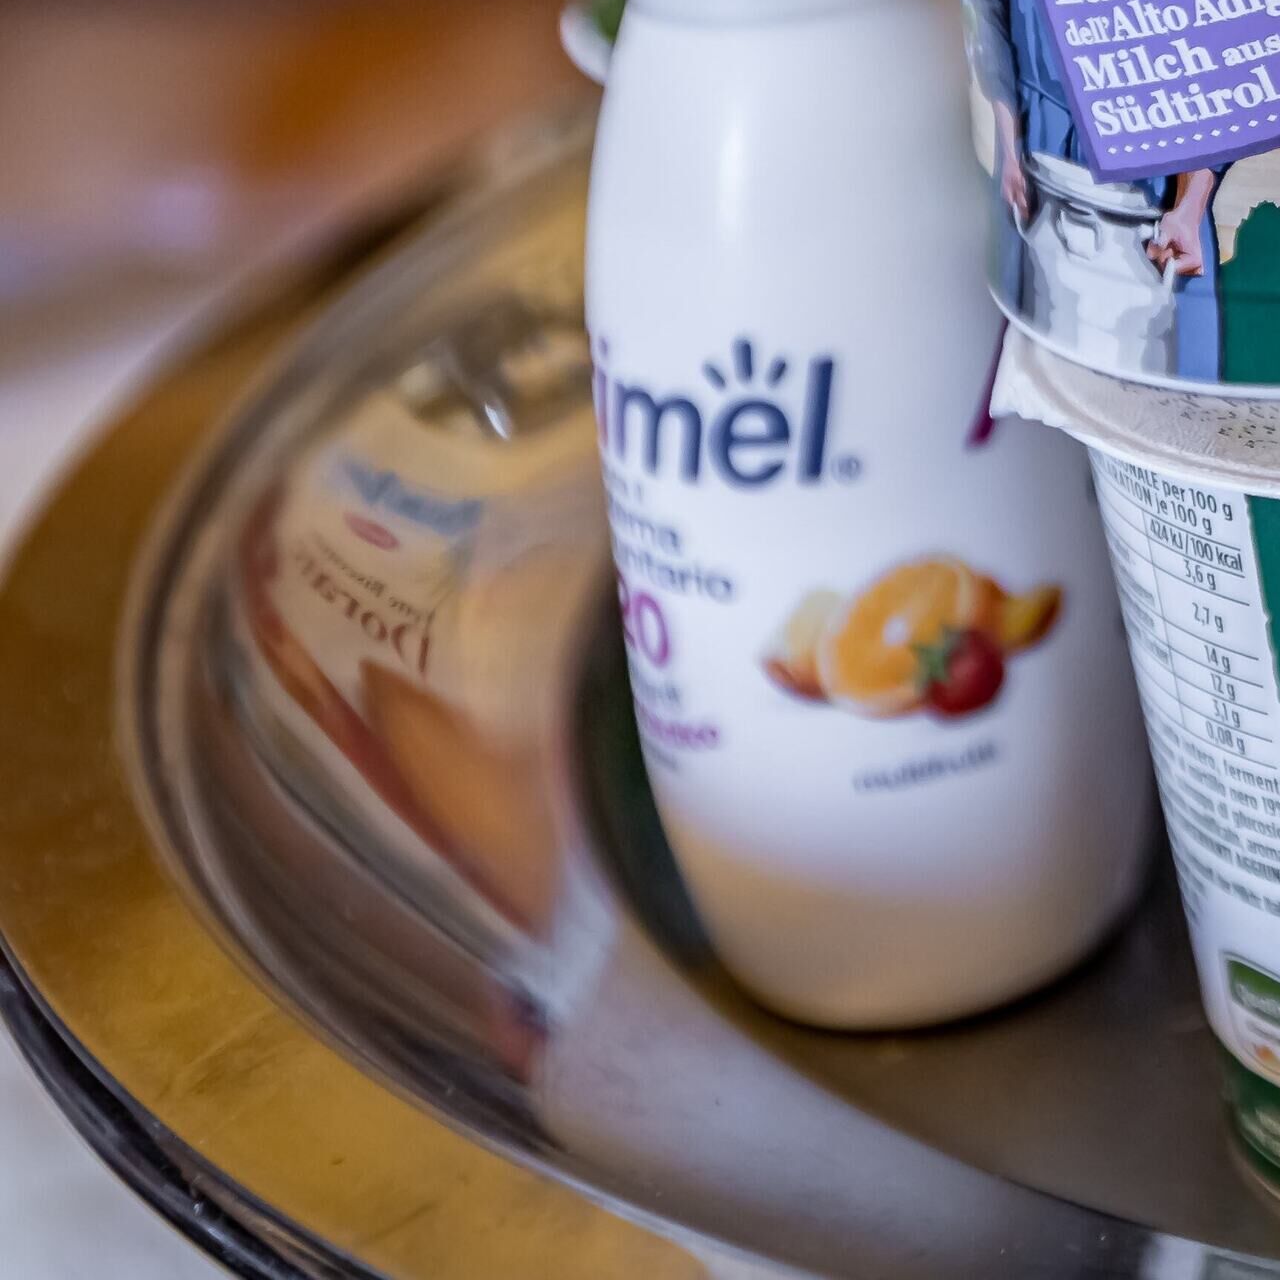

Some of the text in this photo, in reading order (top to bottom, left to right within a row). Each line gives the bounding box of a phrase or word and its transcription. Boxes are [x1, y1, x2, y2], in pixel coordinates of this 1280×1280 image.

[1075, 30, 1214, 94] Milch
[1161, 480, 1186, 502] per
[1189, 488, 1218, 514] 100
[1222, 503, 1234, 521] g
[1172, 500, 1198, 527] 100
[1184, 559, 1205, 584] 3,6
[1216, 546, 1244, 572] kcal
[1192, 602, 1213, 626] 2,7
[1203, 644, 1218, 665] 14
